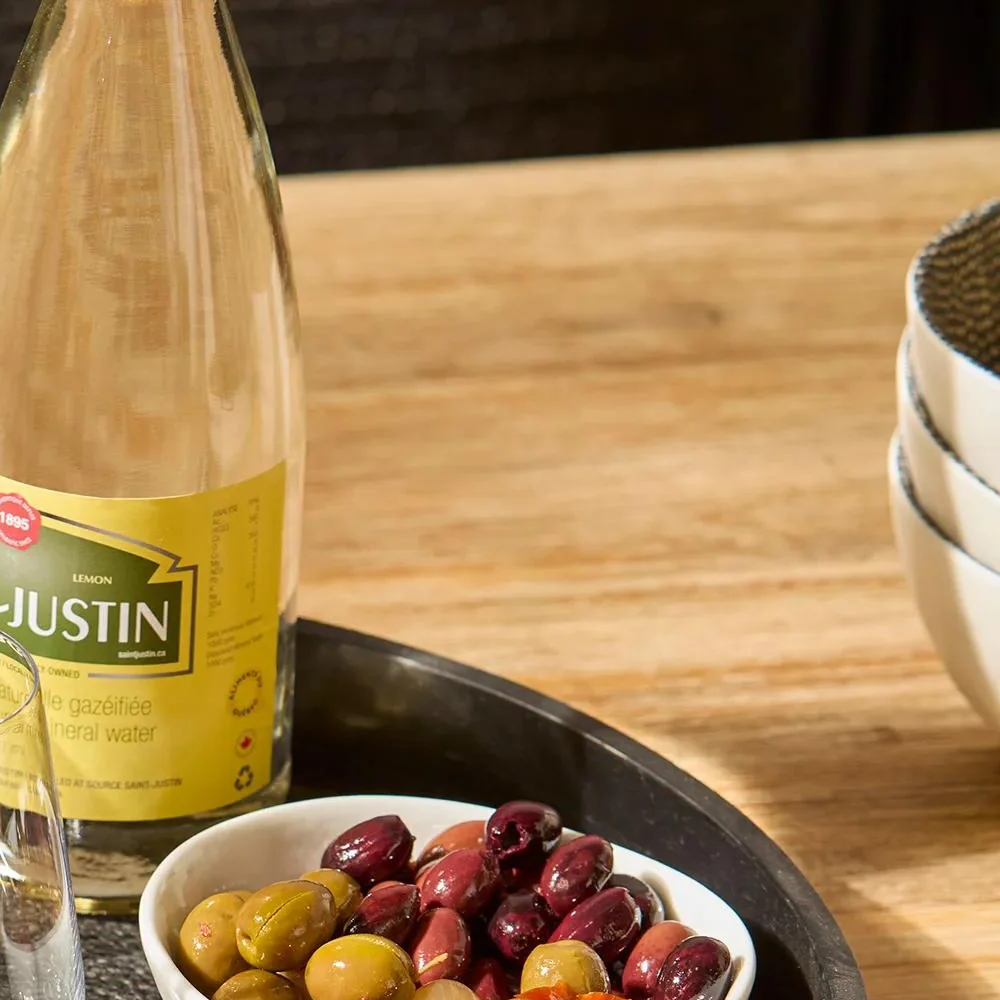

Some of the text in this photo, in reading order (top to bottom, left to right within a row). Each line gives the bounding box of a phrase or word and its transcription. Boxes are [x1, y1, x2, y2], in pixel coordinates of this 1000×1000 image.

[0, 511, 30, 531] 1895
[72, 573, 112, 585] LEMON
[117, 649, 167, 660] saintjustin.ca
[48, 666, 80, 679] OWNED
[69, 694, 152, 718] gazéifiée
[106, 725, 157, 743] water
